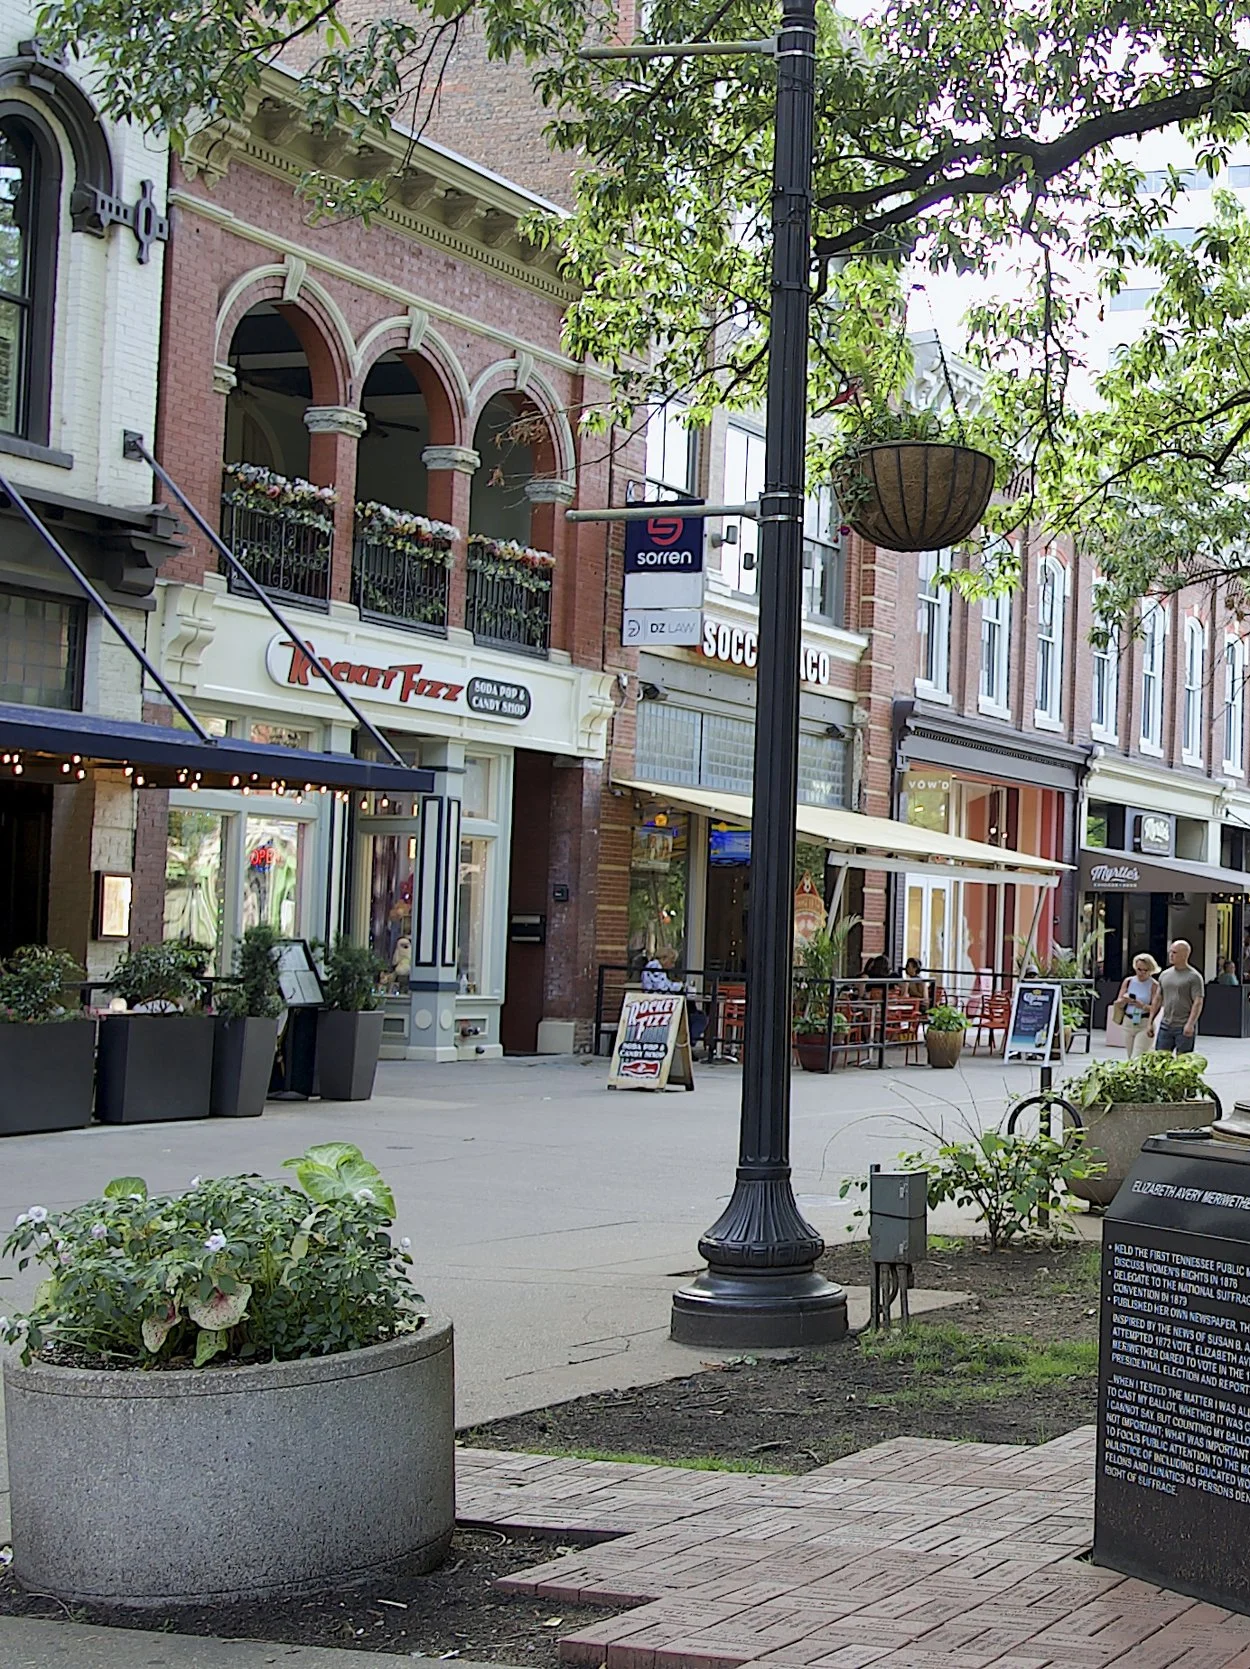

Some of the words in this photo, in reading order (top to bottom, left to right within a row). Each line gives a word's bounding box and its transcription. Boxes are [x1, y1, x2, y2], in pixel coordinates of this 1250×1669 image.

[637, 551, 692, 566] sorren
[650, 622, 666, 634] DZ
[668, 622, 696, 634] LAW
[279, 640, 397, 689] ROCKET
[390, 663, 465, 703] FIZZ
[474, 680, 498, 697] SODA
[499, 685, 518, 700] POP
[471, 696, 501, 711] CANDY
[501, 701, 527, 717] SHOP
[626, 997, 681, 1026] ROCKET
[1132, 1180, 1176, 1198] ELIZABETH
[1174, 1186, 1203, 1202] AVERY
